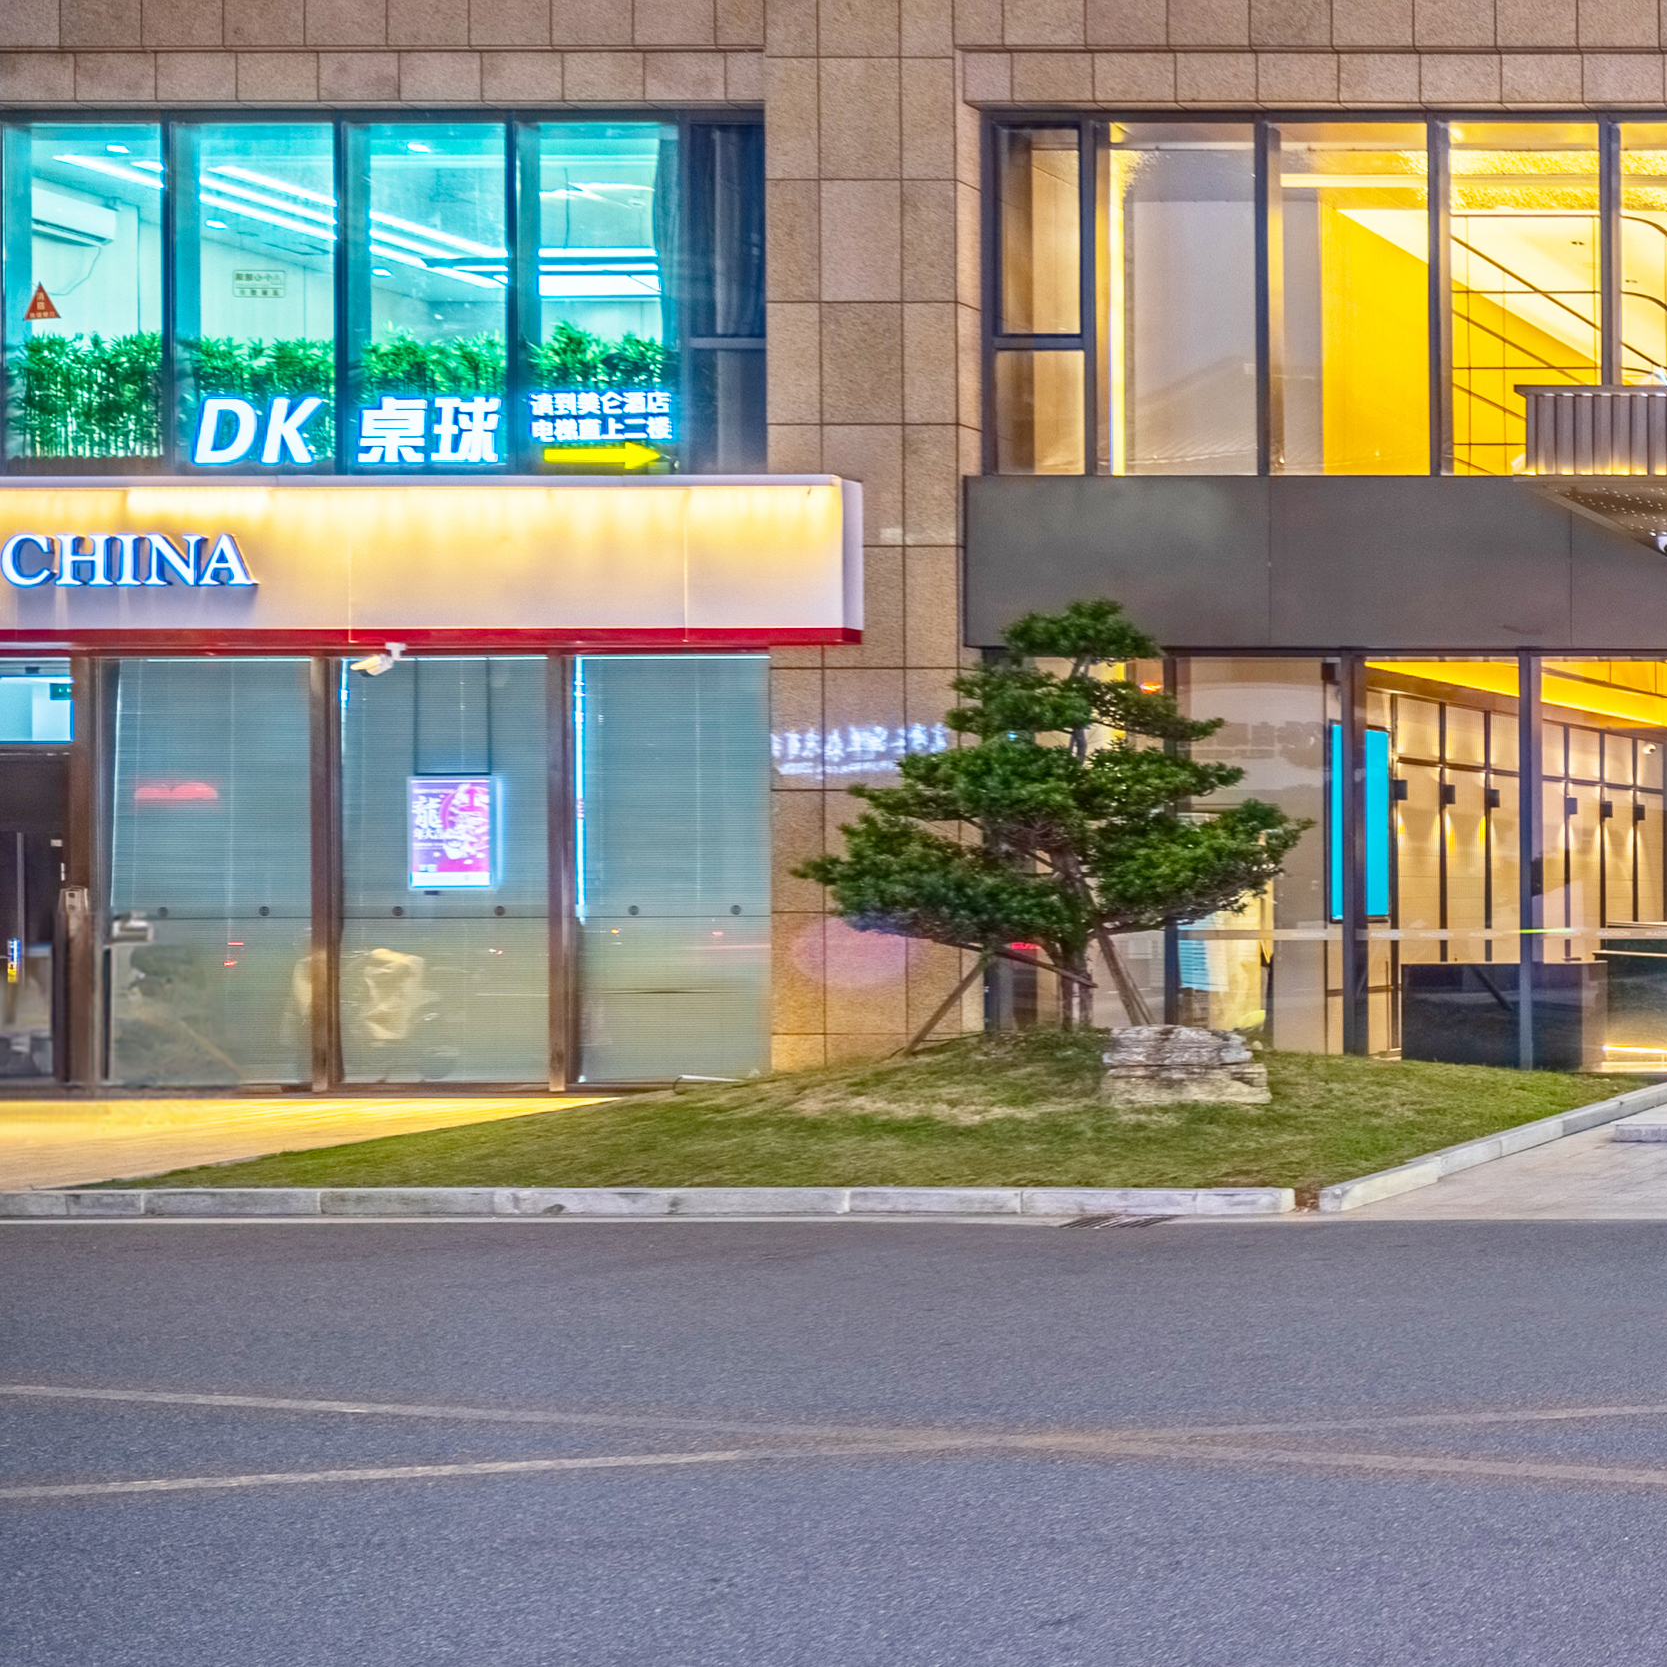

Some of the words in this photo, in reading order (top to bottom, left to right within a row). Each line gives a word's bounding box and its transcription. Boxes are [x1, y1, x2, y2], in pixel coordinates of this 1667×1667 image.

[530, 390, 673, 416] 请到美仑酒店
[193, 395, 324, 465] DK
[357, 395, 502, 466] 桌球
[531, 416, 674, 443] 电梯直上二楼
[0, 532, 260, 587] CHINA
